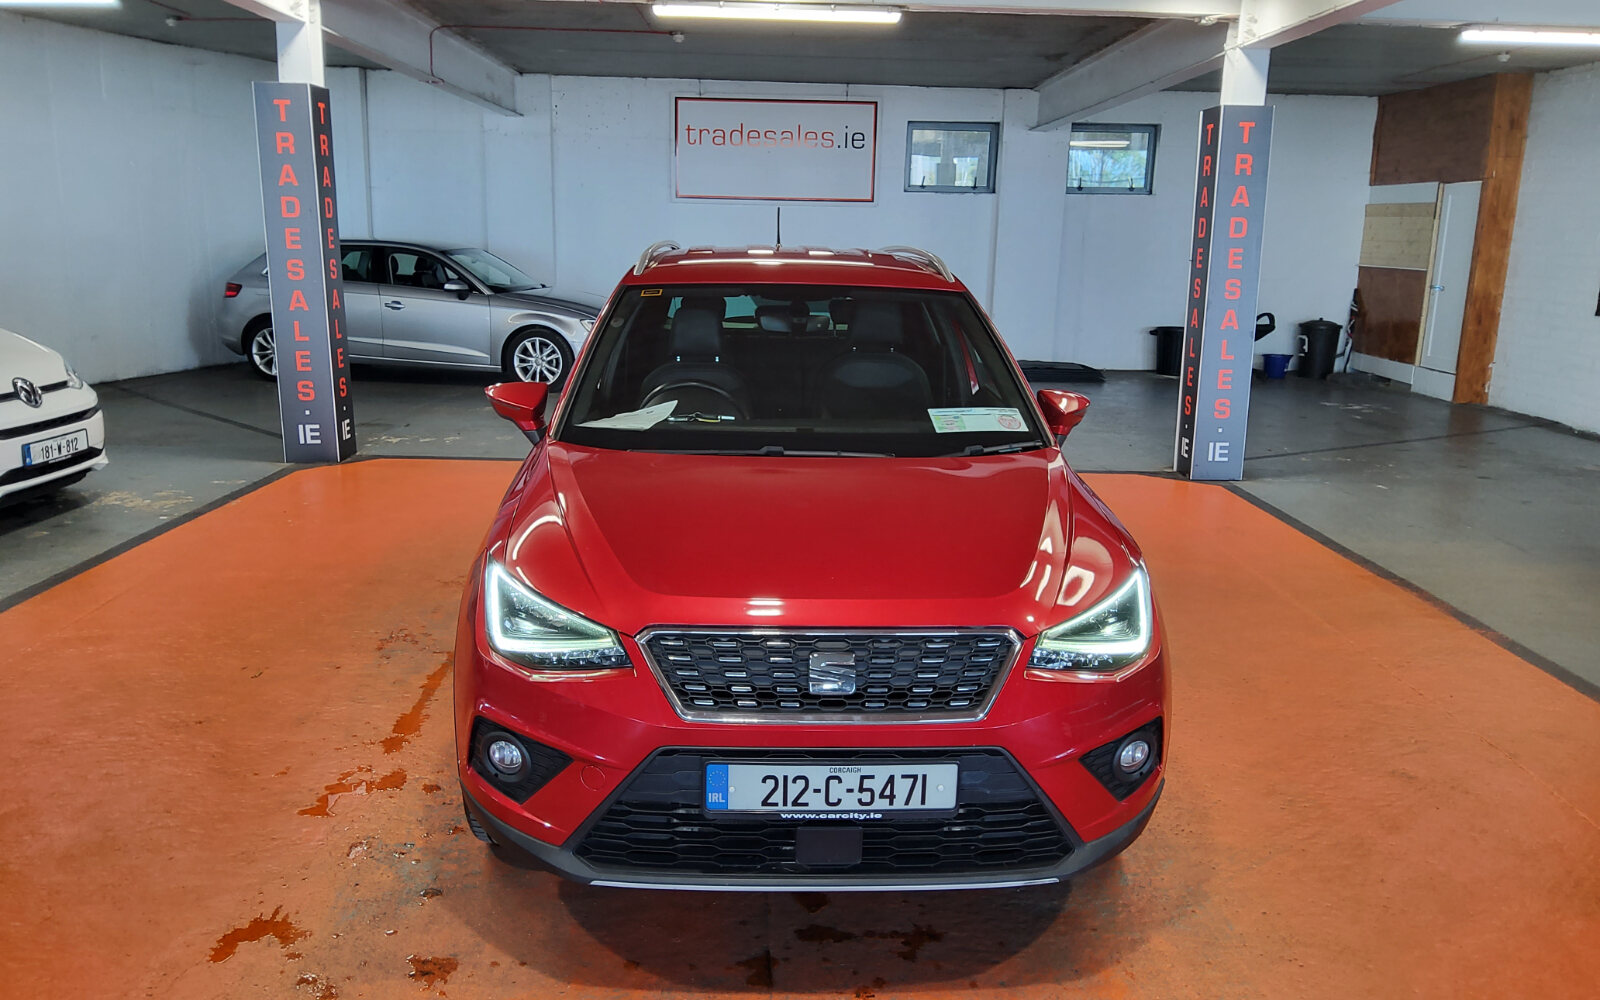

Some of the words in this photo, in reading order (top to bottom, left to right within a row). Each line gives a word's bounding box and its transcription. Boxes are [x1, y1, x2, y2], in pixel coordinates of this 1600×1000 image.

[685, 123, 866, 150] tradesales.ie
[273, 99, 322, 445] TRADESALES.IE
[317, 102, 351, 441] TRADESALES.IE
[1207, 121, 1256, 462] TRADESALES.IE
[829, 766, 862, 774] CORCAIGH
[708, 793, 726, 803] IRL
[761, 773, 928, 807] 212-C-5471
[780, 812, 883, 820] www.carcity.ie
